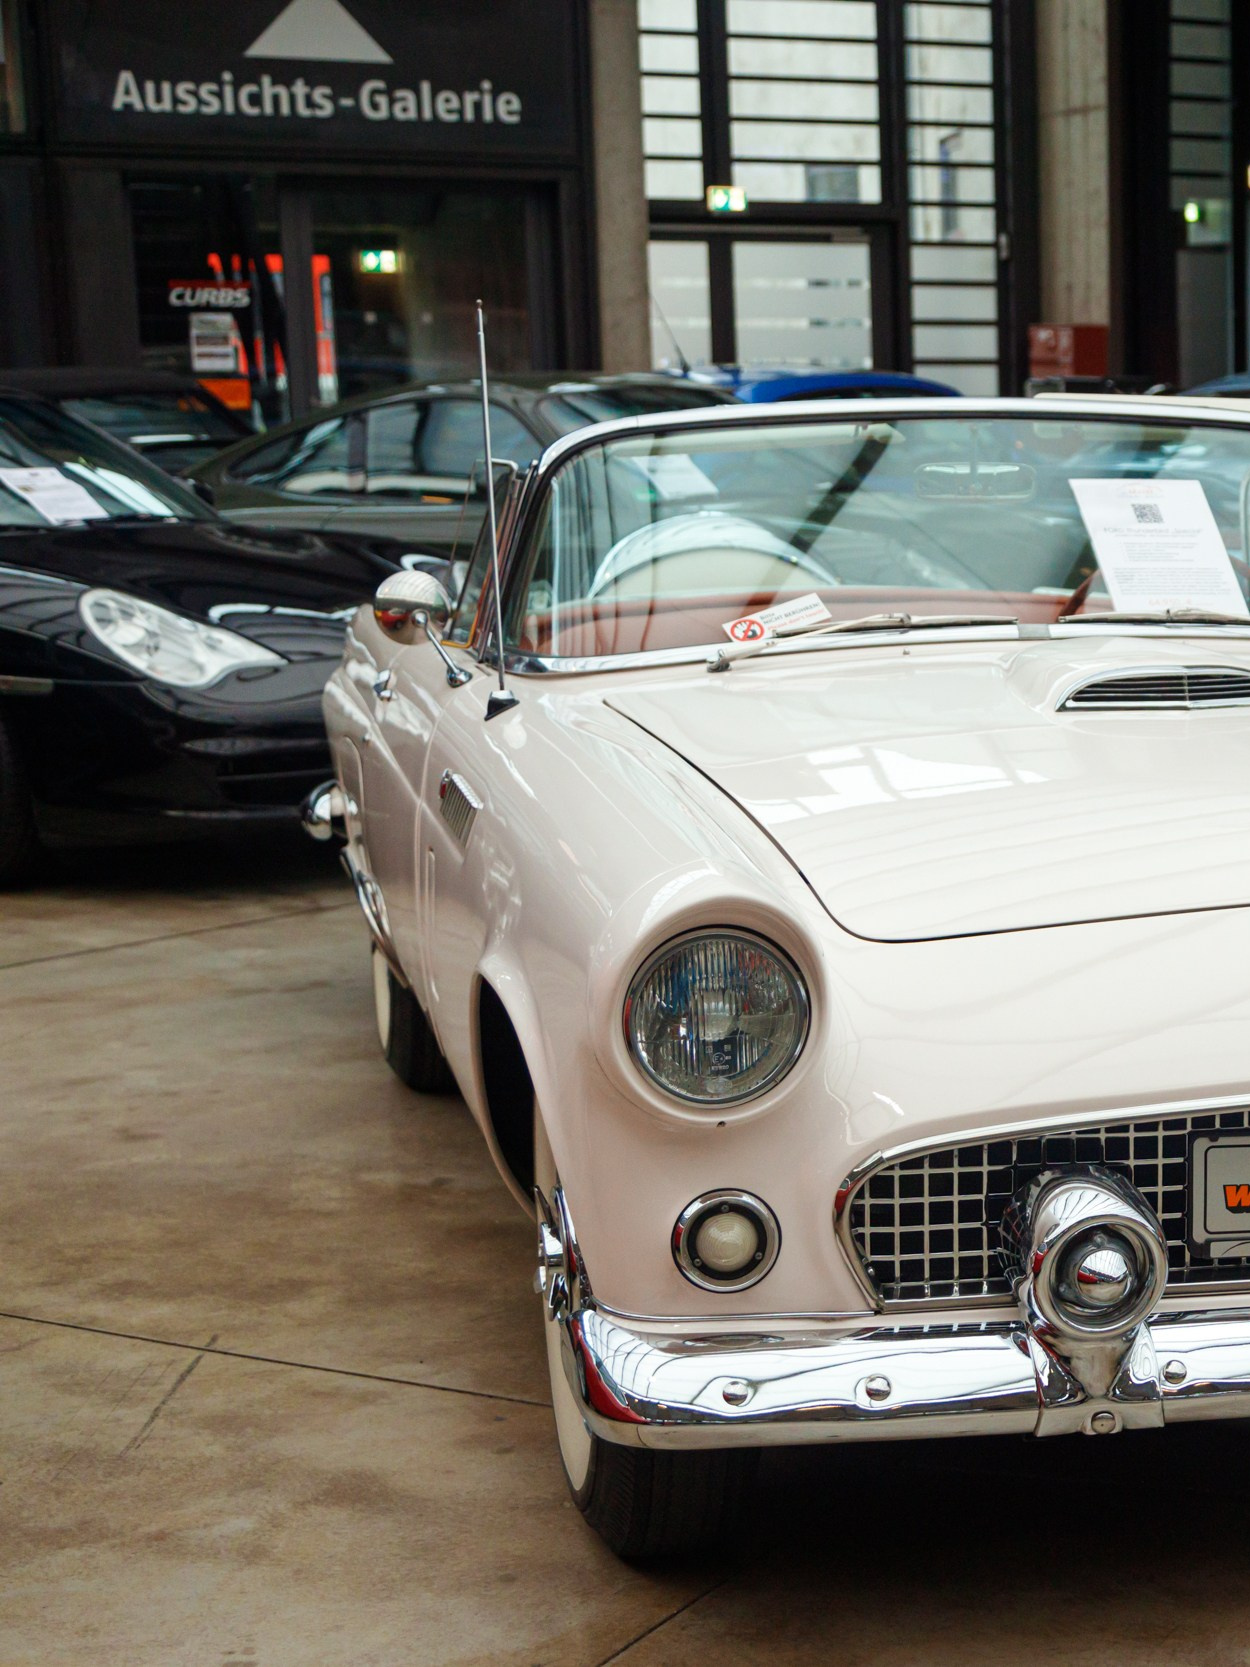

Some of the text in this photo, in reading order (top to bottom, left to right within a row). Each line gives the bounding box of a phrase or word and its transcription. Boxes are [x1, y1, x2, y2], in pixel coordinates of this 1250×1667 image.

[112, 69, 522, 124] Aussichts-Galerie
[168, 287, 251, 308] CURBS
[763, 615, 784, 624] NICHT
